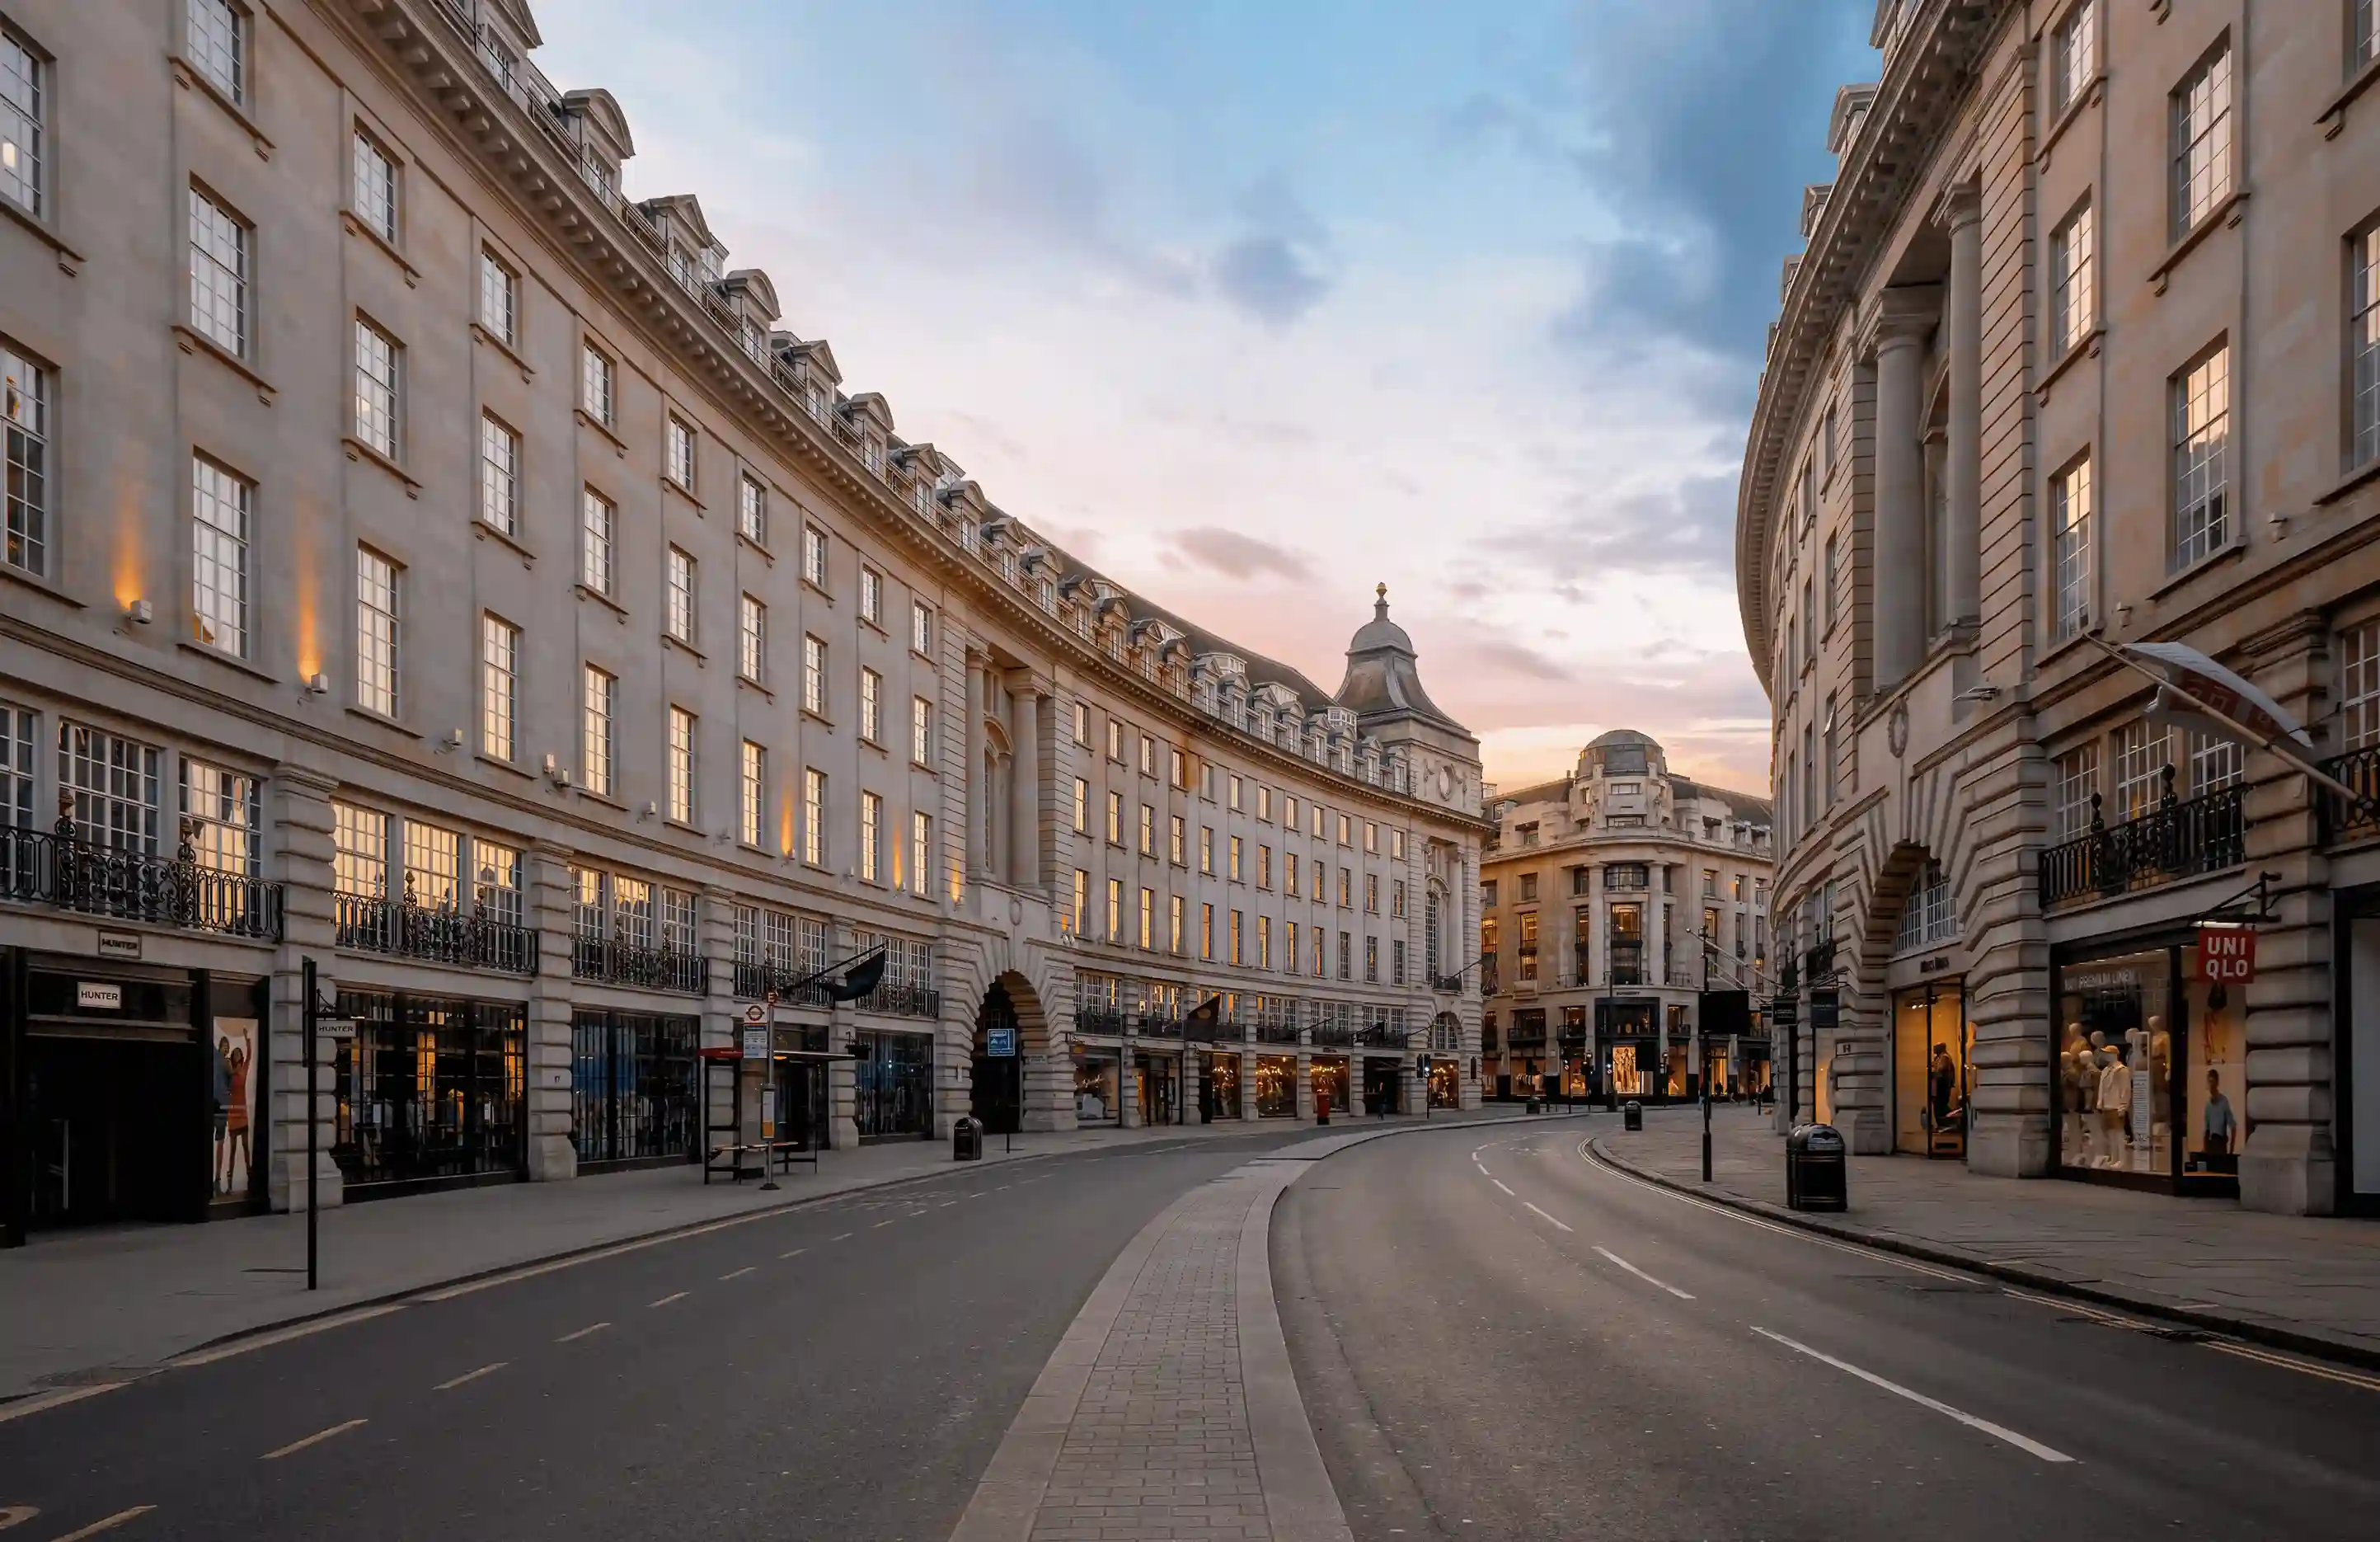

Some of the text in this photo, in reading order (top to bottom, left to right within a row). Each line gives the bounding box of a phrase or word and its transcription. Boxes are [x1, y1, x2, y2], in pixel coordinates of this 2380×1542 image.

[101, 938, 138, 950] HUNTER
[2208, 936, 2246, 955] UNI
[2205, 958, 2248, 980] QLO
[81, 990, 118, 1000] HUNTER
